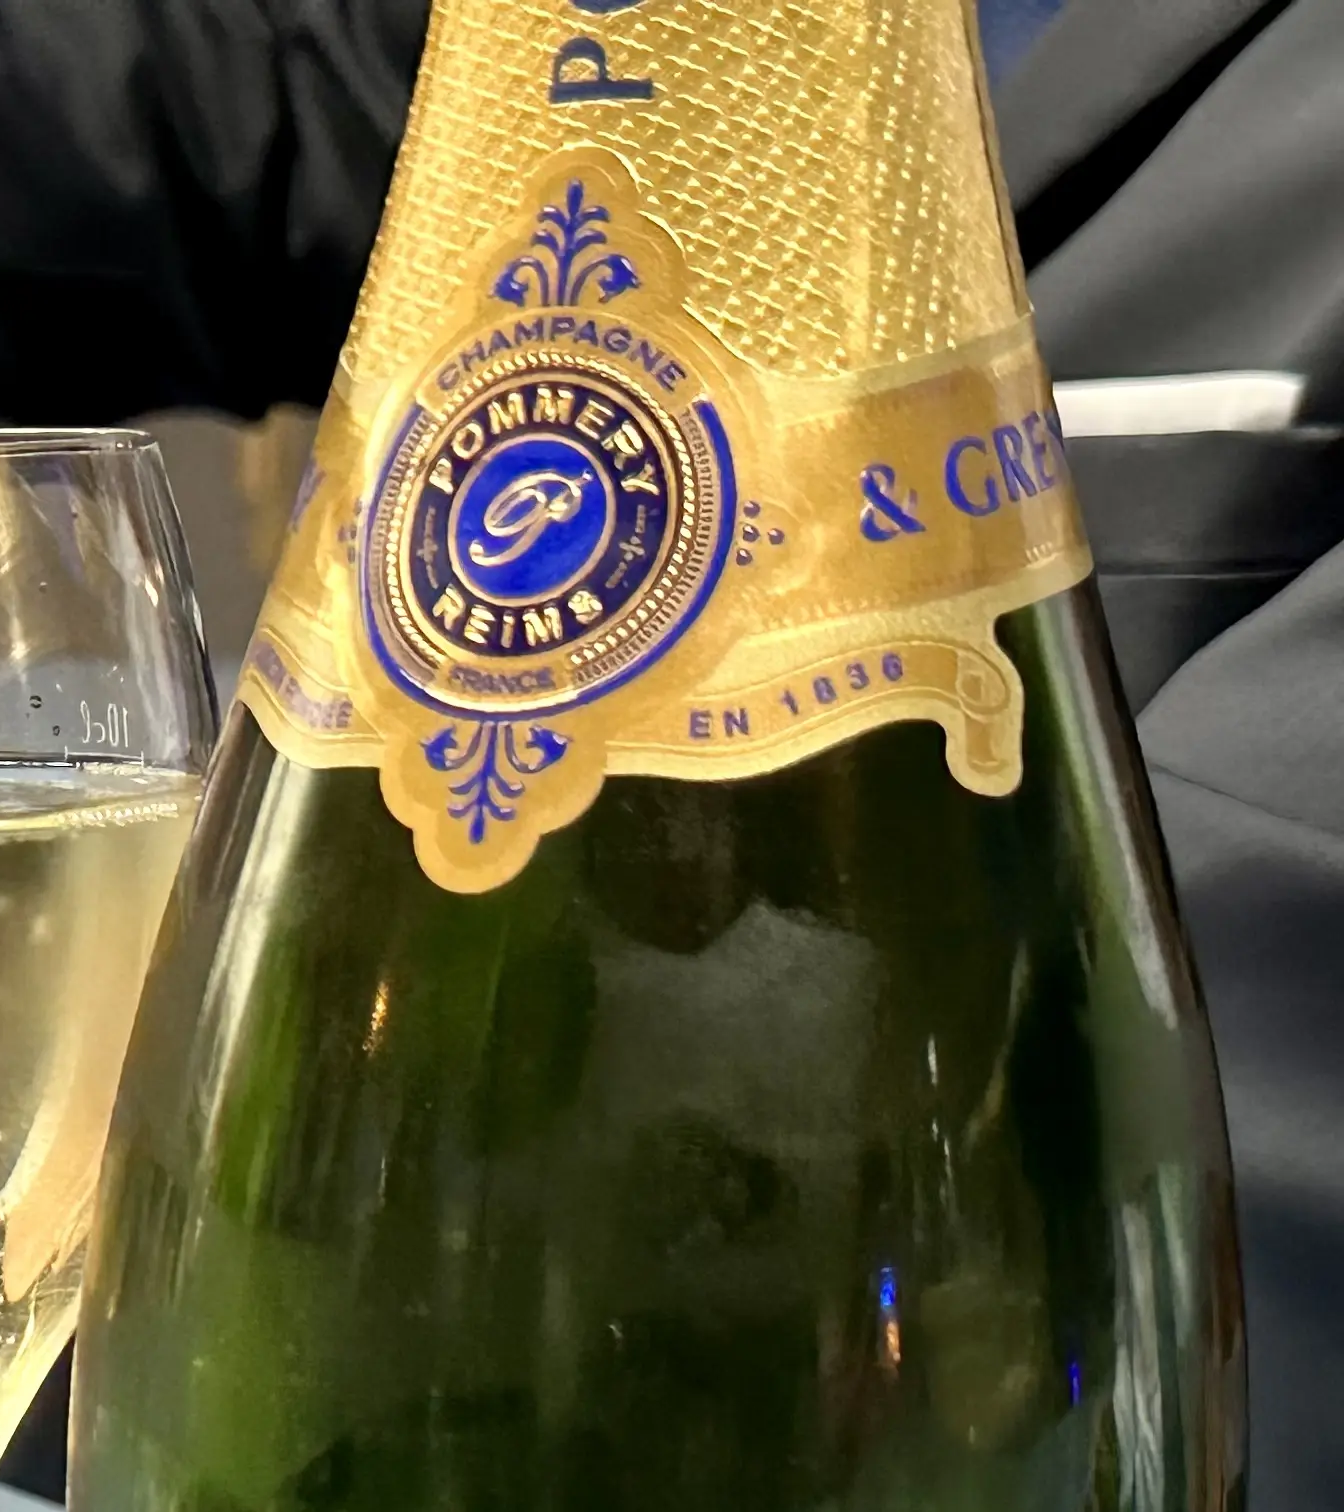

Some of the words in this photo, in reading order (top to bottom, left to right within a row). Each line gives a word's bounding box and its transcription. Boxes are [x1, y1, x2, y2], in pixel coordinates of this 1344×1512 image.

[549, 0, 654, 104] P
[436, 316, 688, 392] CHAMPAGNE
[428, 384, 661, 496] POMMERY
[859, 463, 927, 542] &
[432, 584, 604, 650] REIMS
[448, 665, 556, 696] FRANCE
[688, 707, 750, 740] EN
